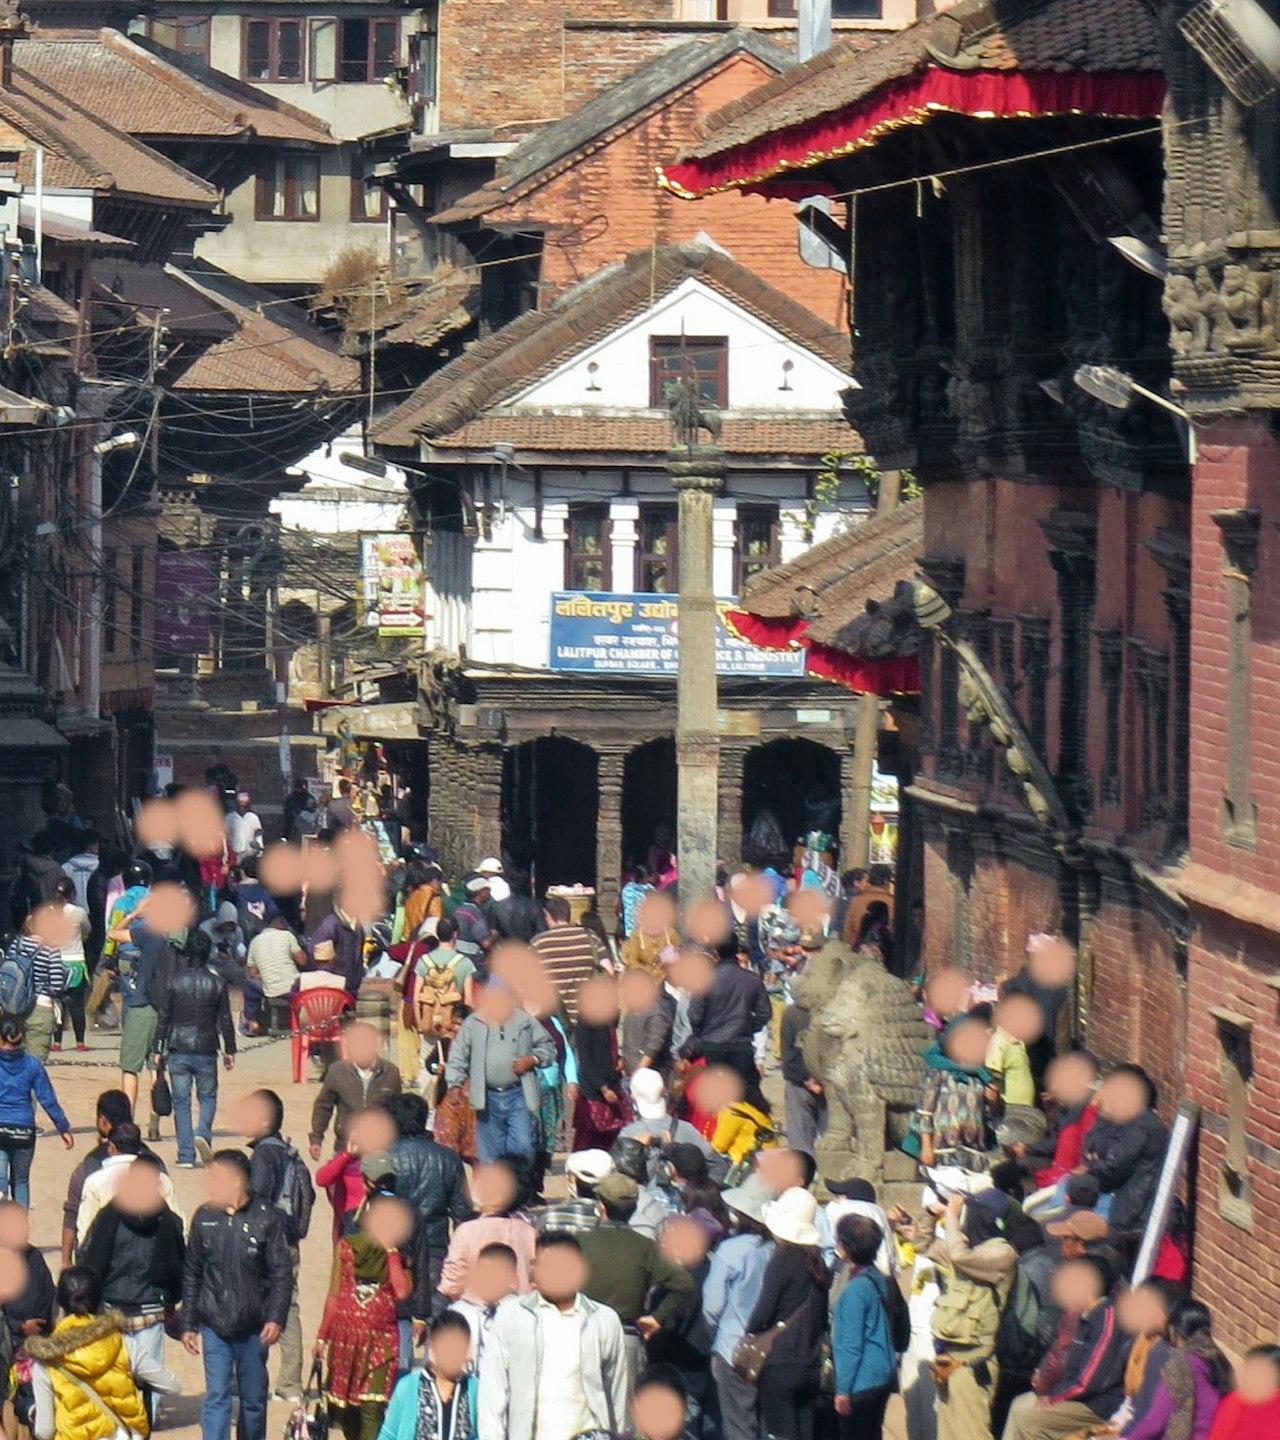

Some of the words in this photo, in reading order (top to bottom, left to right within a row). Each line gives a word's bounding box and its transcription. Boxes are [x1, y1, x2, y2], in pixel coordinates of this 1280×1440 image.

[556, 596, 634, 625] ललितपुर
[557, 646, 608, 659] LALITPUR
[609, 647, 660, 660] CHAMBER
[661, 648, 672, 659] OF
[745, 651, 800, 663] INDUSTRY
